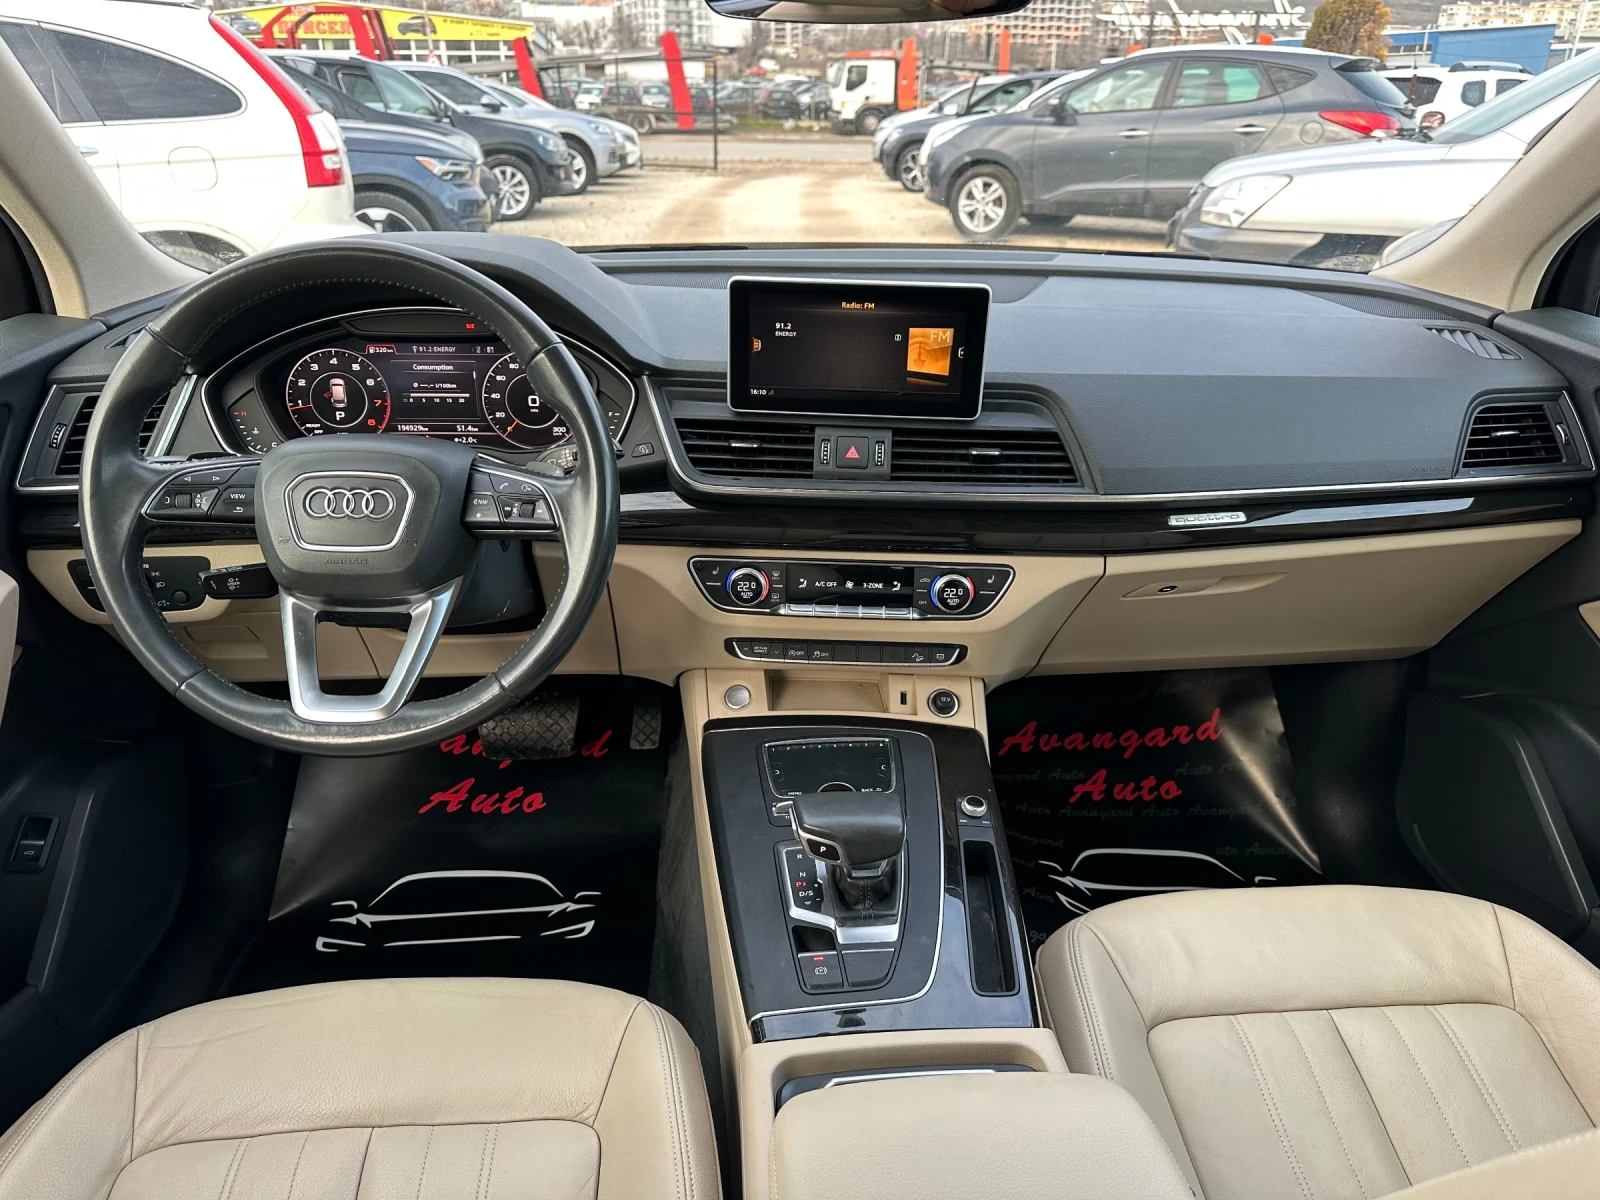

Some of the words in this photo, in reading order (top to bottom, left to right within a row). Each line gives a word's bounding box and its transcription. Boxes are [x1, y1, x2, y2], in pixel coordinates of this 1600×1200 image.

[841, 301, 863, 309] Radio:
[775, 322, 792, 330] 91.2
[930, 330, 951, 343] FM
[329, 357, 338, 365] 4
[310, 363, 319, 371] 3
[351, 363, 361, 371] 5
[412, 363, 454, 372] Consumption
[297, 378, 306, 386] 2
[366, 378, 375, 386] 6
[373, 399, 382, 407] 7
[527, 395, 540, 407] 0
[335, 411, 345, 421] P
[367, 418, 376, 426] 8
[1174, 514, 1240, 524] quattro
[324, 557, 368, 565] AIRBAG
[996, 706, 1224, 759] Avangard
[1068, 767, 1183, 804] Auto
[417, 776, 547, 815] Auto
[819, 845, 827, 853] P
